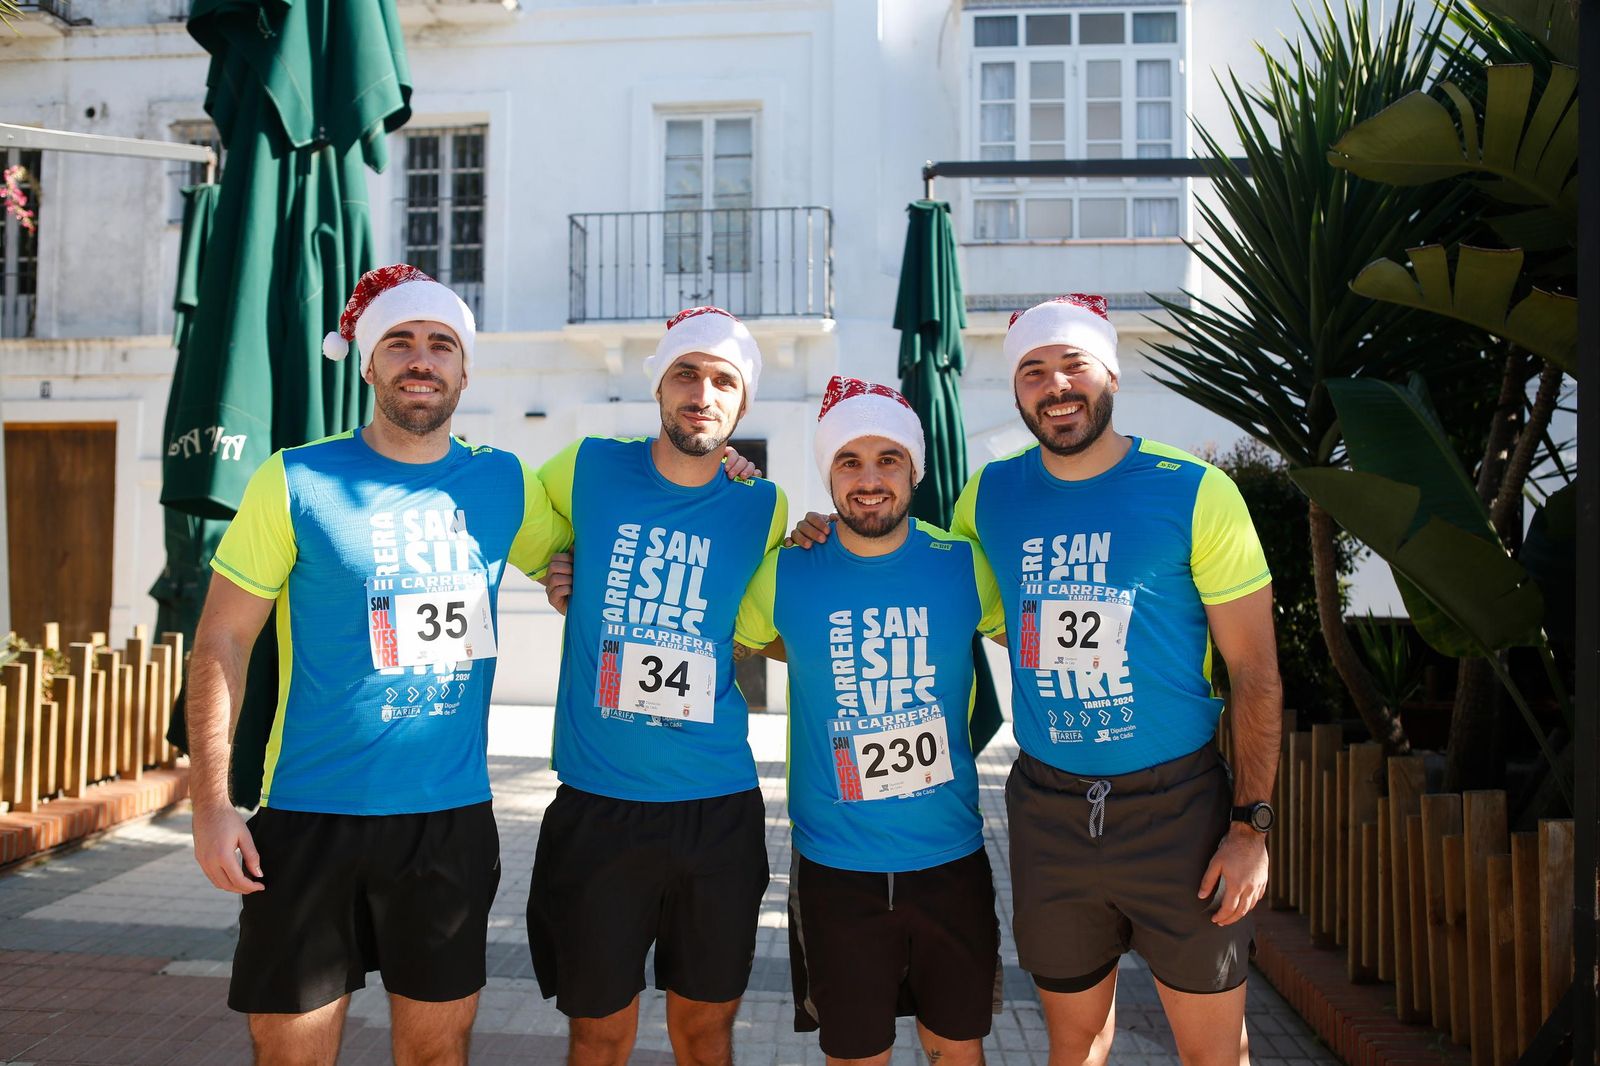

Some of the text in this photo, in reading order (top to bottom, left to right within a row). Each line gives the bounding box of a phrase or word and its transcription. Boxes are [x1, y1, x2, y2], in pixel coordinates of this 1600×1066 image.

[403, 509, 467, 541] SAN
[370, 511, 400, 576] RERA
[645, 527, 711, 567] SAN
[1051, 532, 1111, 566] SAN
[602, 523, 642, 622] ARRERA
[373, 578, 393, 591] III
[634, 557, 708, 610] SIL
[1026, 584, 1131, 600] III CARRERA
[371, 597, 389, 611] SAN
[1022, 600, 1037, 613] SAN
[372, 611, 391, 630] SIL
[416, 601, 468, 642] 35
[629, 598, 705, 635] VES
[862, 607, 929, 638] SAN
[1021, 613, 1037, 631] SIL
[374, 629, 397, 650] VES
[607, 624, 714, 652] III CARRERA
[1057, 611, 1101, 649] 32
[603, 639, 620, 654] SAN
[655, 640, 688, 652] TARIFA
[1021, 631, 1040, 650] VES
[601, 653, 617, 671] SIL
[861, 636, 935, 679] SIL
[1019, 649, 1040, 668] TRE
[600, 671, 621, 691] VES
[638, 655, 691, 697] 34
[598, 689, 620, 708] TRE
[859, 676, 937, 716] VES
[1083, 695, 1134, 709] TARIFA 2024
[393, 708, 421, 717] TARIFA
[610, 708, 635, 720] TARIFA
[833, 704, 941, 731] III CARRERA
[881, 721, 915, 732] TARIFA
[1057, 732, 1083, 740] TARIFA
[833, 736, 849, 750] SAN
[835, 750, 853, 767] SIL
[862, 731, 937, 779] 230
[837, 766, 860, 784] VES
[840, 783, 863, 800] TRE
